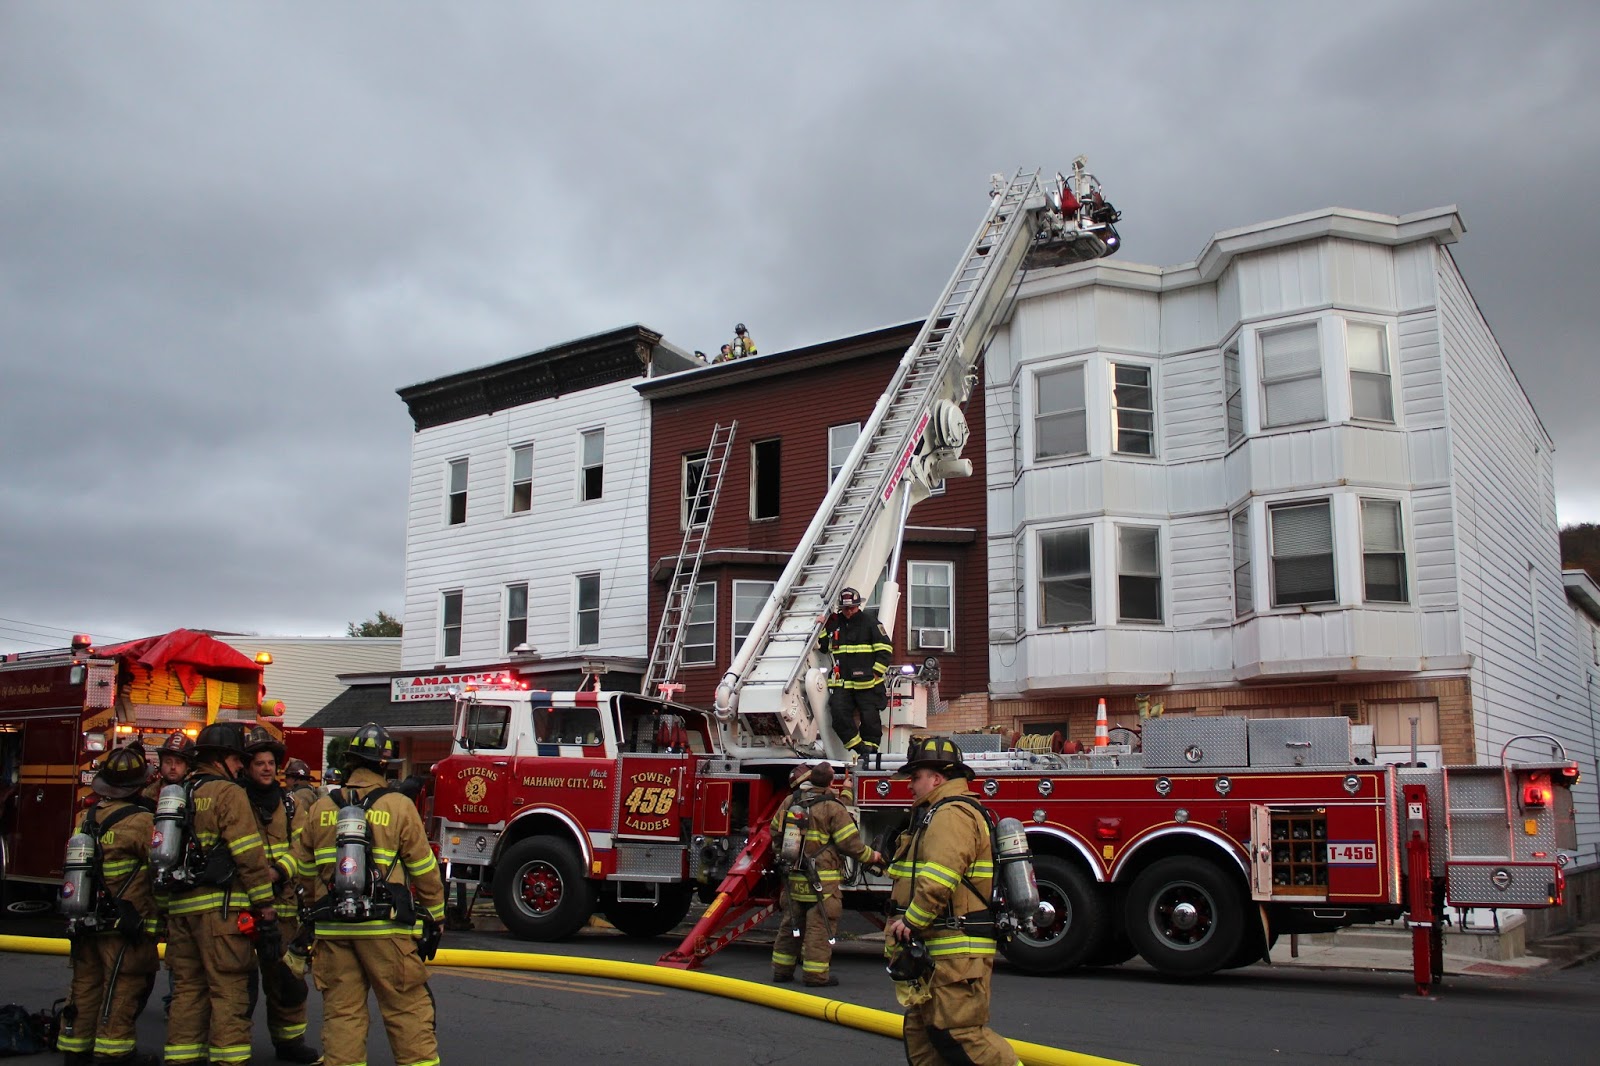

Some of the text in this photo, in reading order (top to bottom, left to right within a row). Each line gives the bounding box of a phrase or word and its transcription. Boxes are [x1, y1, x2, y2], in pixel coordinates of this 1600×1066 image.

[172, 735, 182, 745] 2
[457, 767, 499, 781] CITIZENS
[589, 768, 608, 778] Mack
[630, 771, 672, 787] TOWER
[522, 776, 565, 787] MAHANOY
[592, 779, 607, 789] PA.
[472, 784, 479, 795] 2
[625, 786, 676, 815] 456
[462, 804, 489, 814] FIRE CO.
[625, 816, 671, 831] LADDER
[1329, 846, 1374, 860] T-456
